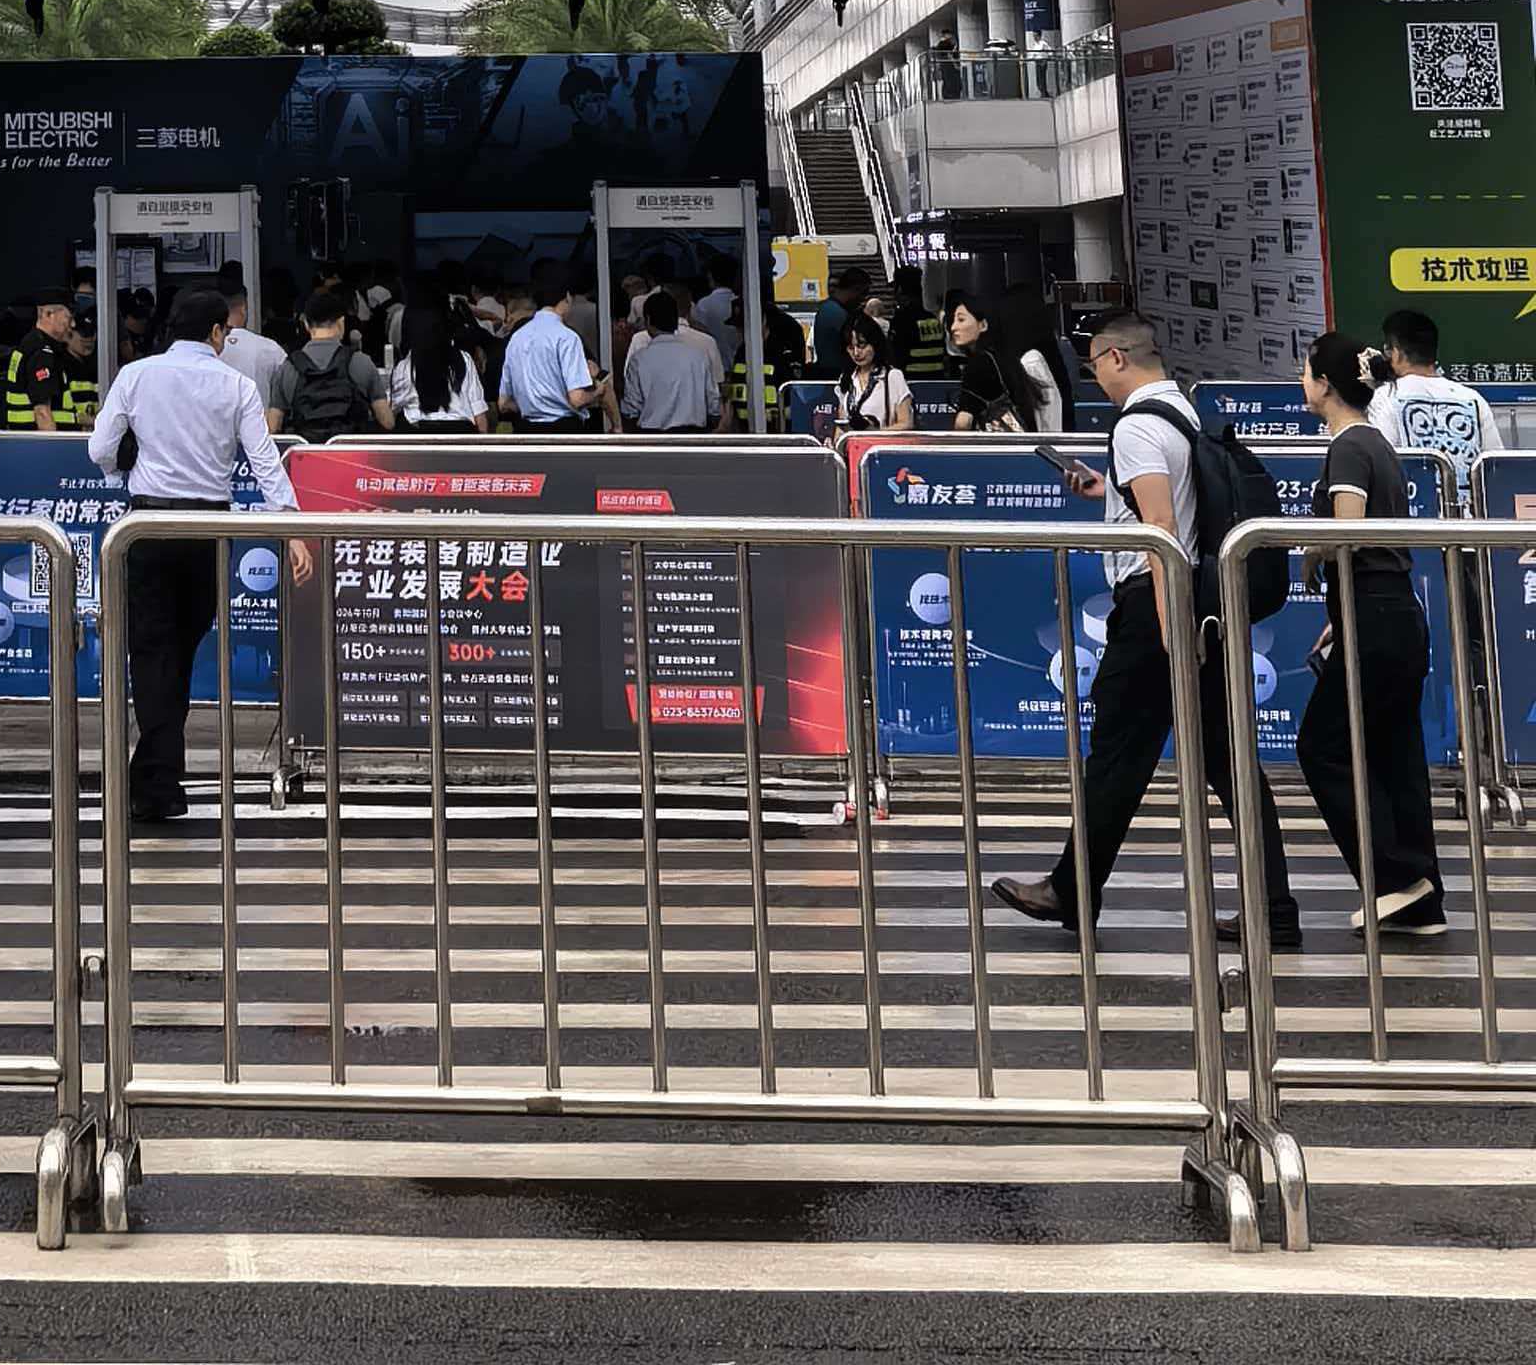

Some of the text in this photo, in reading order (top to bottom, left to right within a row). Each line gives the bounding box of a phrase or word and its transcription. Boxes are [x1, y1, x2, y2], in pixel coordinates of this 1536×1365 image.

[4, 111, 112, 130] MITSUBISHI
[5, 130, 98, 149] ELECTRIC
[136, 126, 220, 148] 三菱电机
[12, 153, 34, 169] for
[38, 153, 61, 168] the
[66, 152, 112, 167] Better
[1421, 257, 1530, 282] 技术攻坚
[907, 484, 977, 506] 嘉友荟
[342, 642, 386, 660] 150+
[448, 642, 496, 661] 300+
